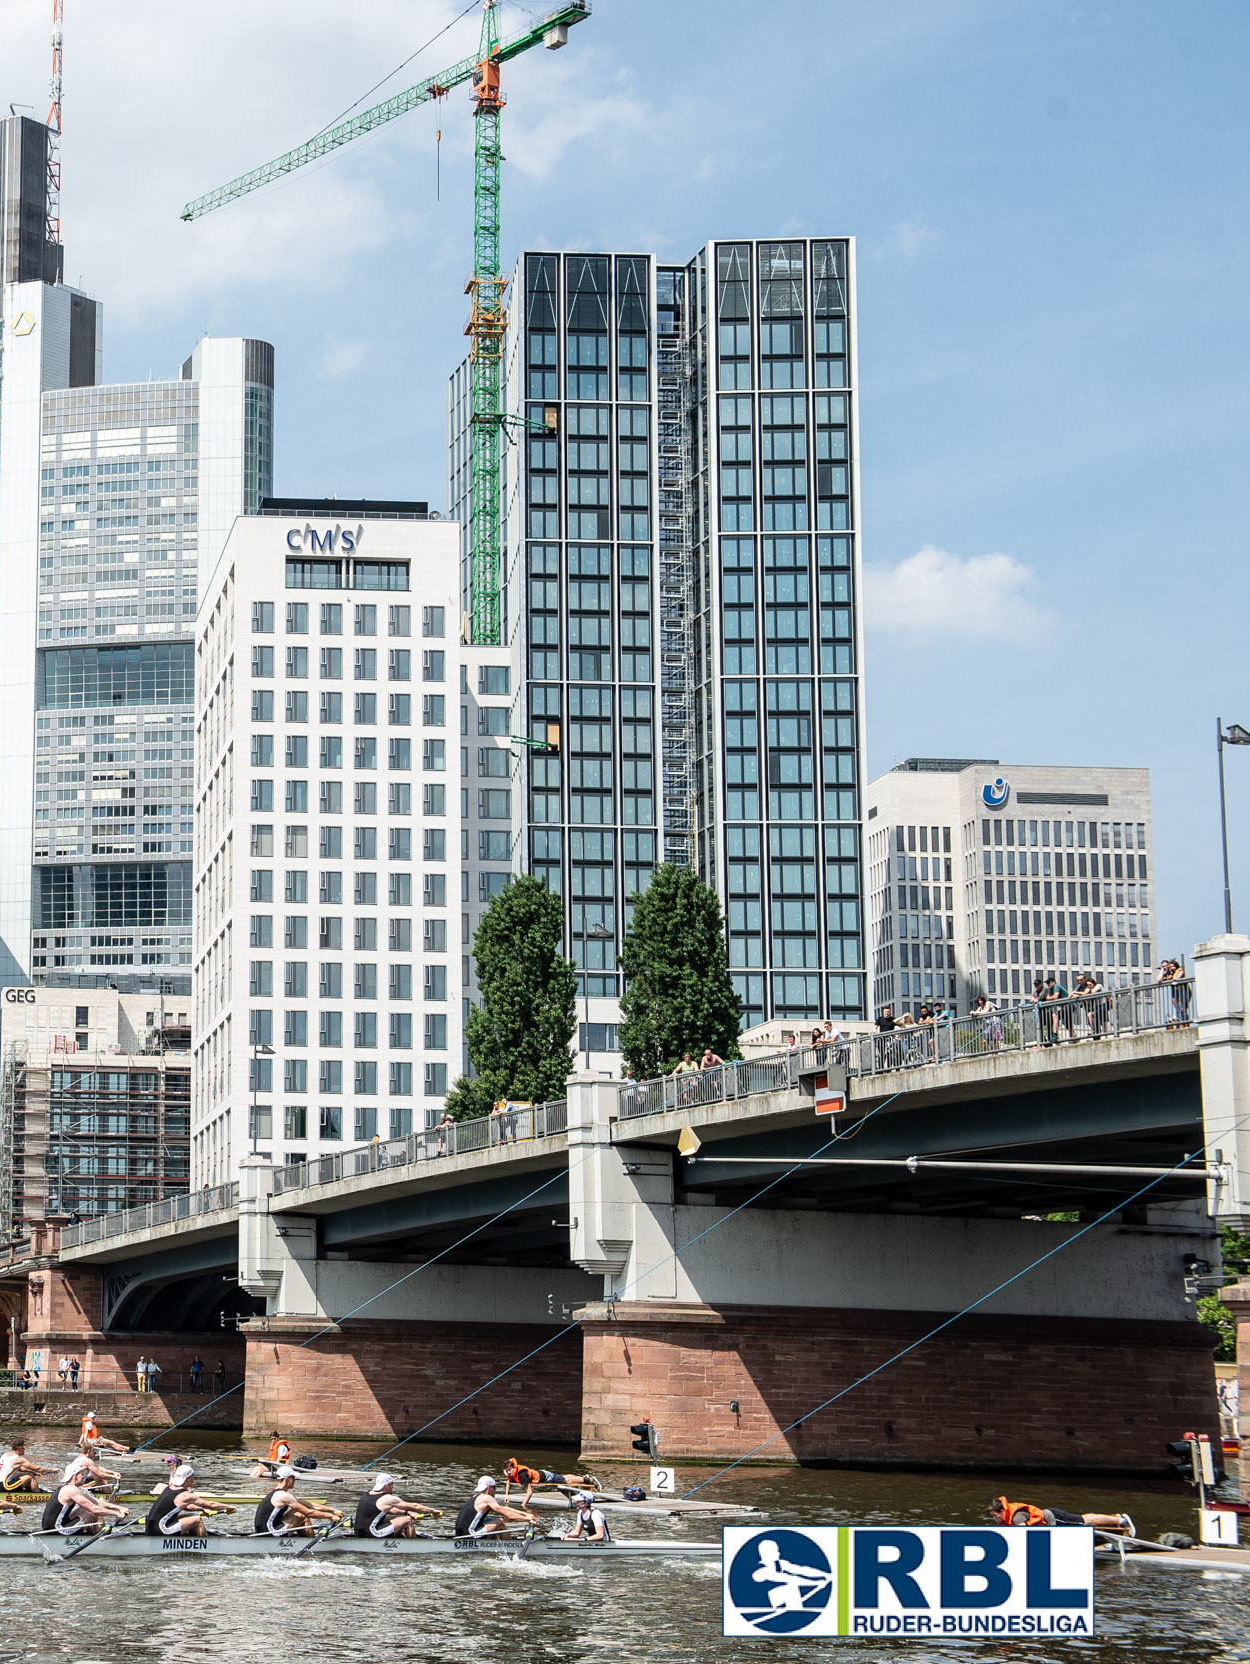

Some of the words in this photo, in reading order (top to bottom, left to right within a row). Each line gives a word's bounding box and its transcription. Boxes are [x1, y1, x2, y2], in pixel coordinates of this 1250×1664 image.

[5, 989, 36, 1003] GEG
[656, 1470, 668, 1489] 2
[14, 1493, 50, 1503] Sparkasse
[1211, 1515, 1222, 1539] 1
[162, 1539, 208, 1550] MINDEN
[462, 1540, 479, 1548] RBL
